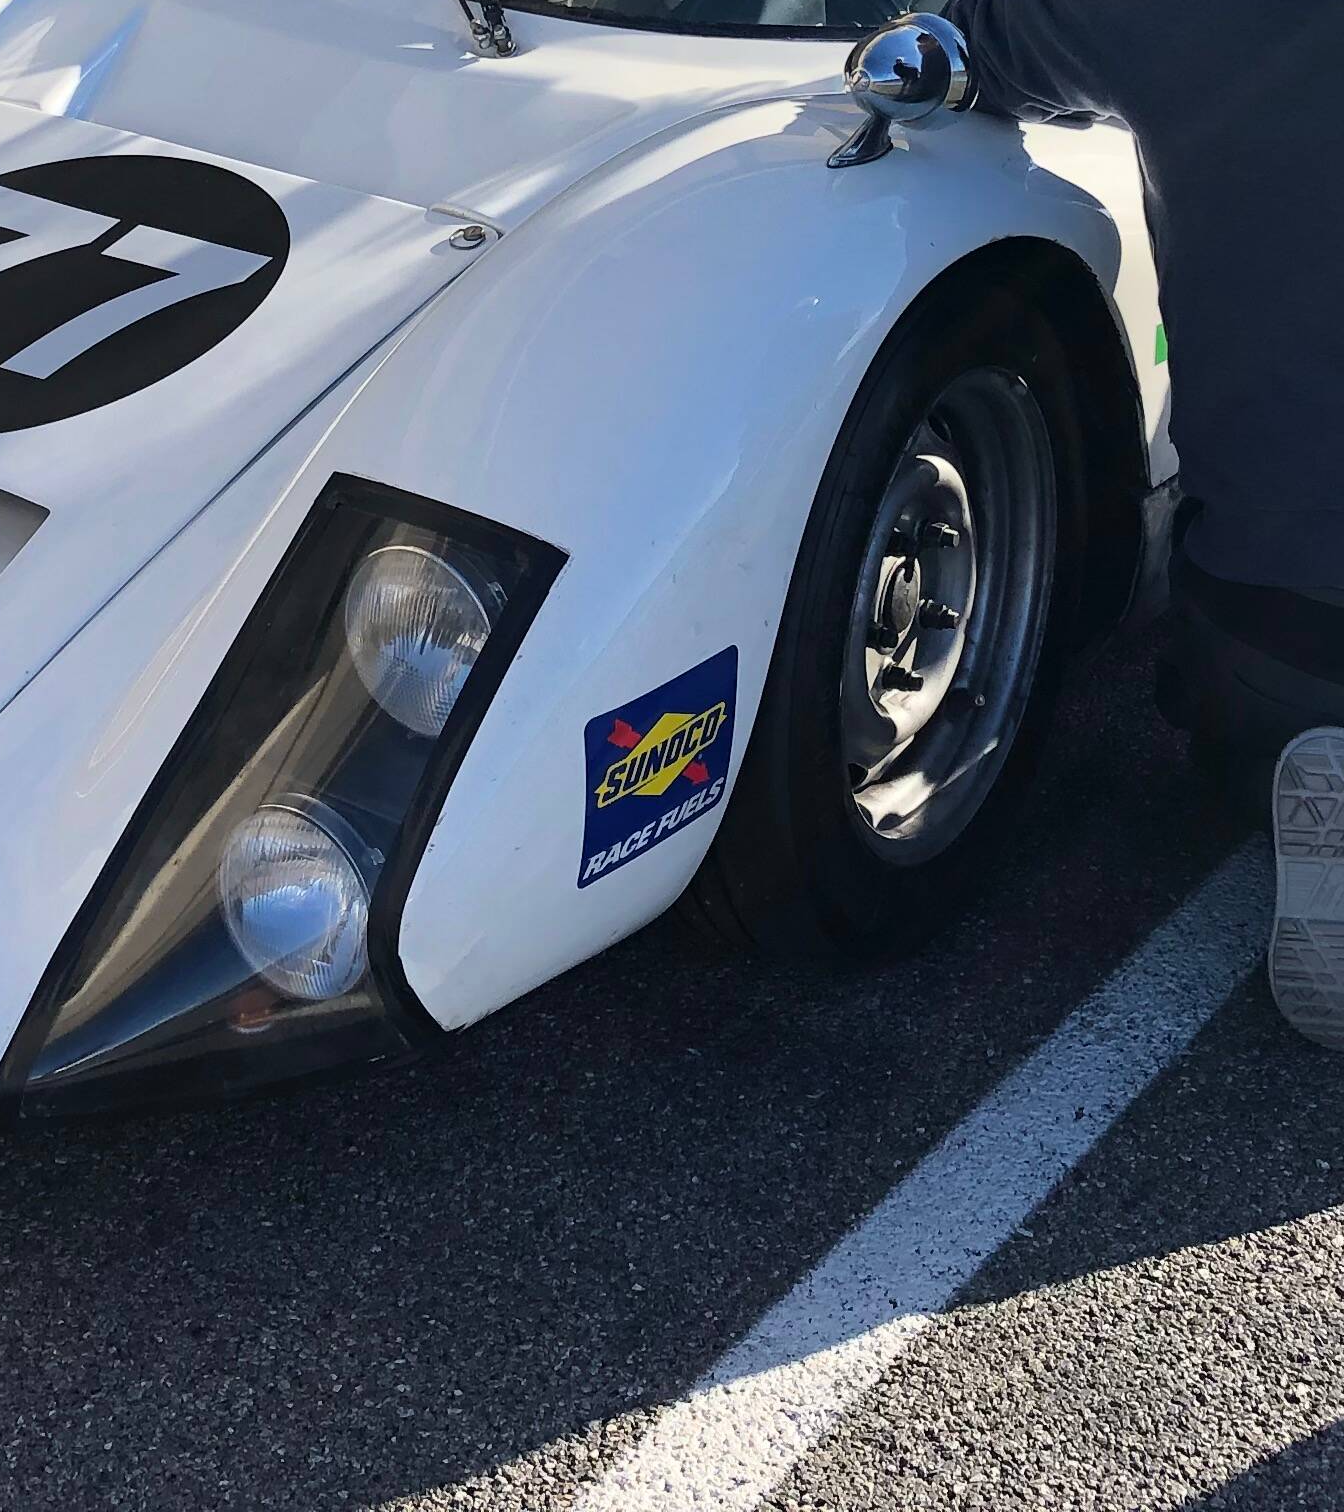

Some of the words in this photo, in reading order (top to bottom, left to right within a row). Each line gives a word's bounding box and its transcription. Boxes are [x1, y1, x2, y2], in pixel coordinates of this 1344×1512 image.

[605, 707, 722, 798] SUNOCO
[582, 820, 657, 881] RACE
[653, 776, 725, 840] FUELS
